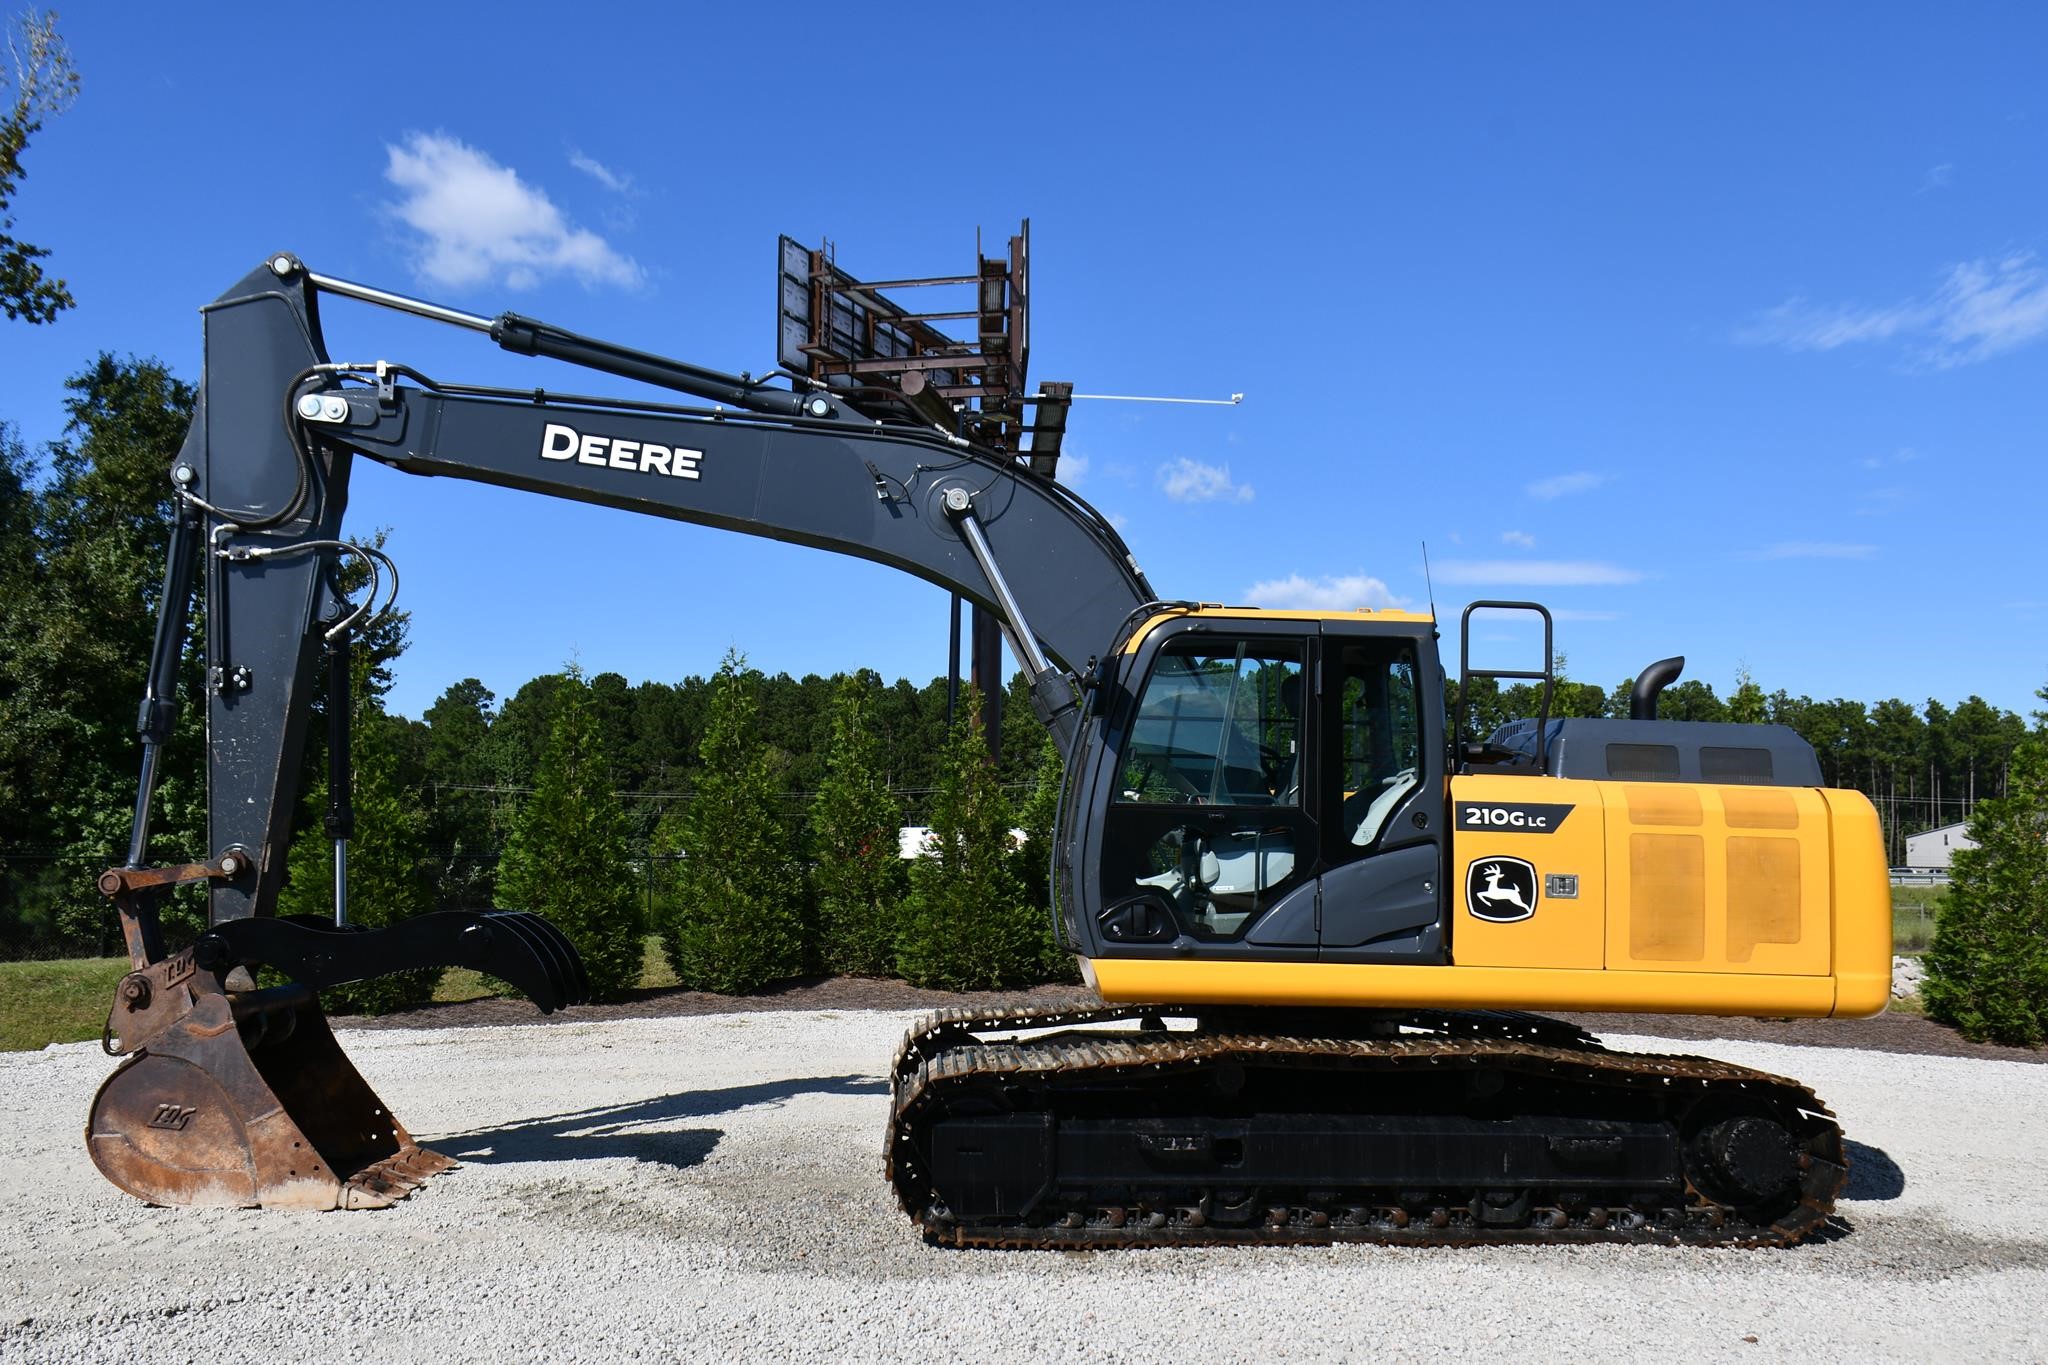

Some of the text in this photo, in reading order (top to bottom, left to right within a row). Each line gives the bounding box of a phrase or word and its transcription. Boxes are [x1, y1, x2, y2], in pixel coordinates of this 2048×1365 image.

[541, 423, 703, 480] DEERE
[1466, 807, 1547, 827] 210G LC
